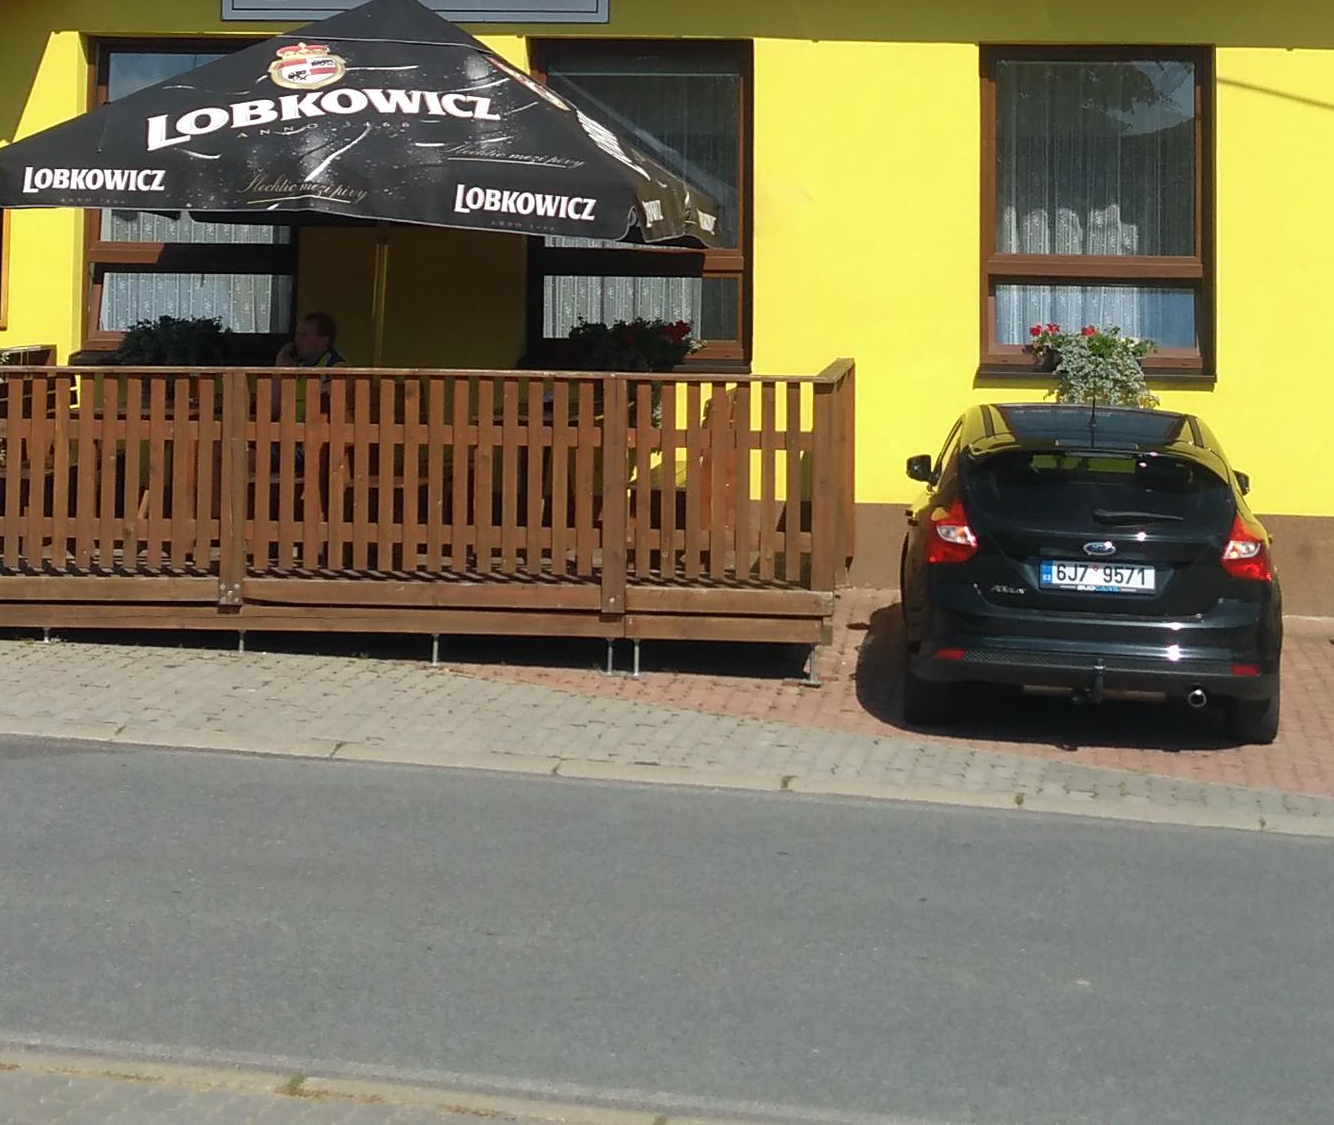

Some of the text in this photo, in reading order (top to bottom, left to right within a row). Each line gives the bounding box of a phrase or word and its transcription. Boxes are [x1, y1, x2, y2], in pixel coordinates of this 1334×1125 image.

[147, 87, 501, 152] LOBKOWICZ
[237, 123, 318, 139] ANNO
[23, 166, 166, 194] LOBKOWICZ
[454, 183, 597, 222] LOBKOWICZ
[1056, 563, 1089, 582] 6J7
[1103, 565, 1146, 586] 9571
